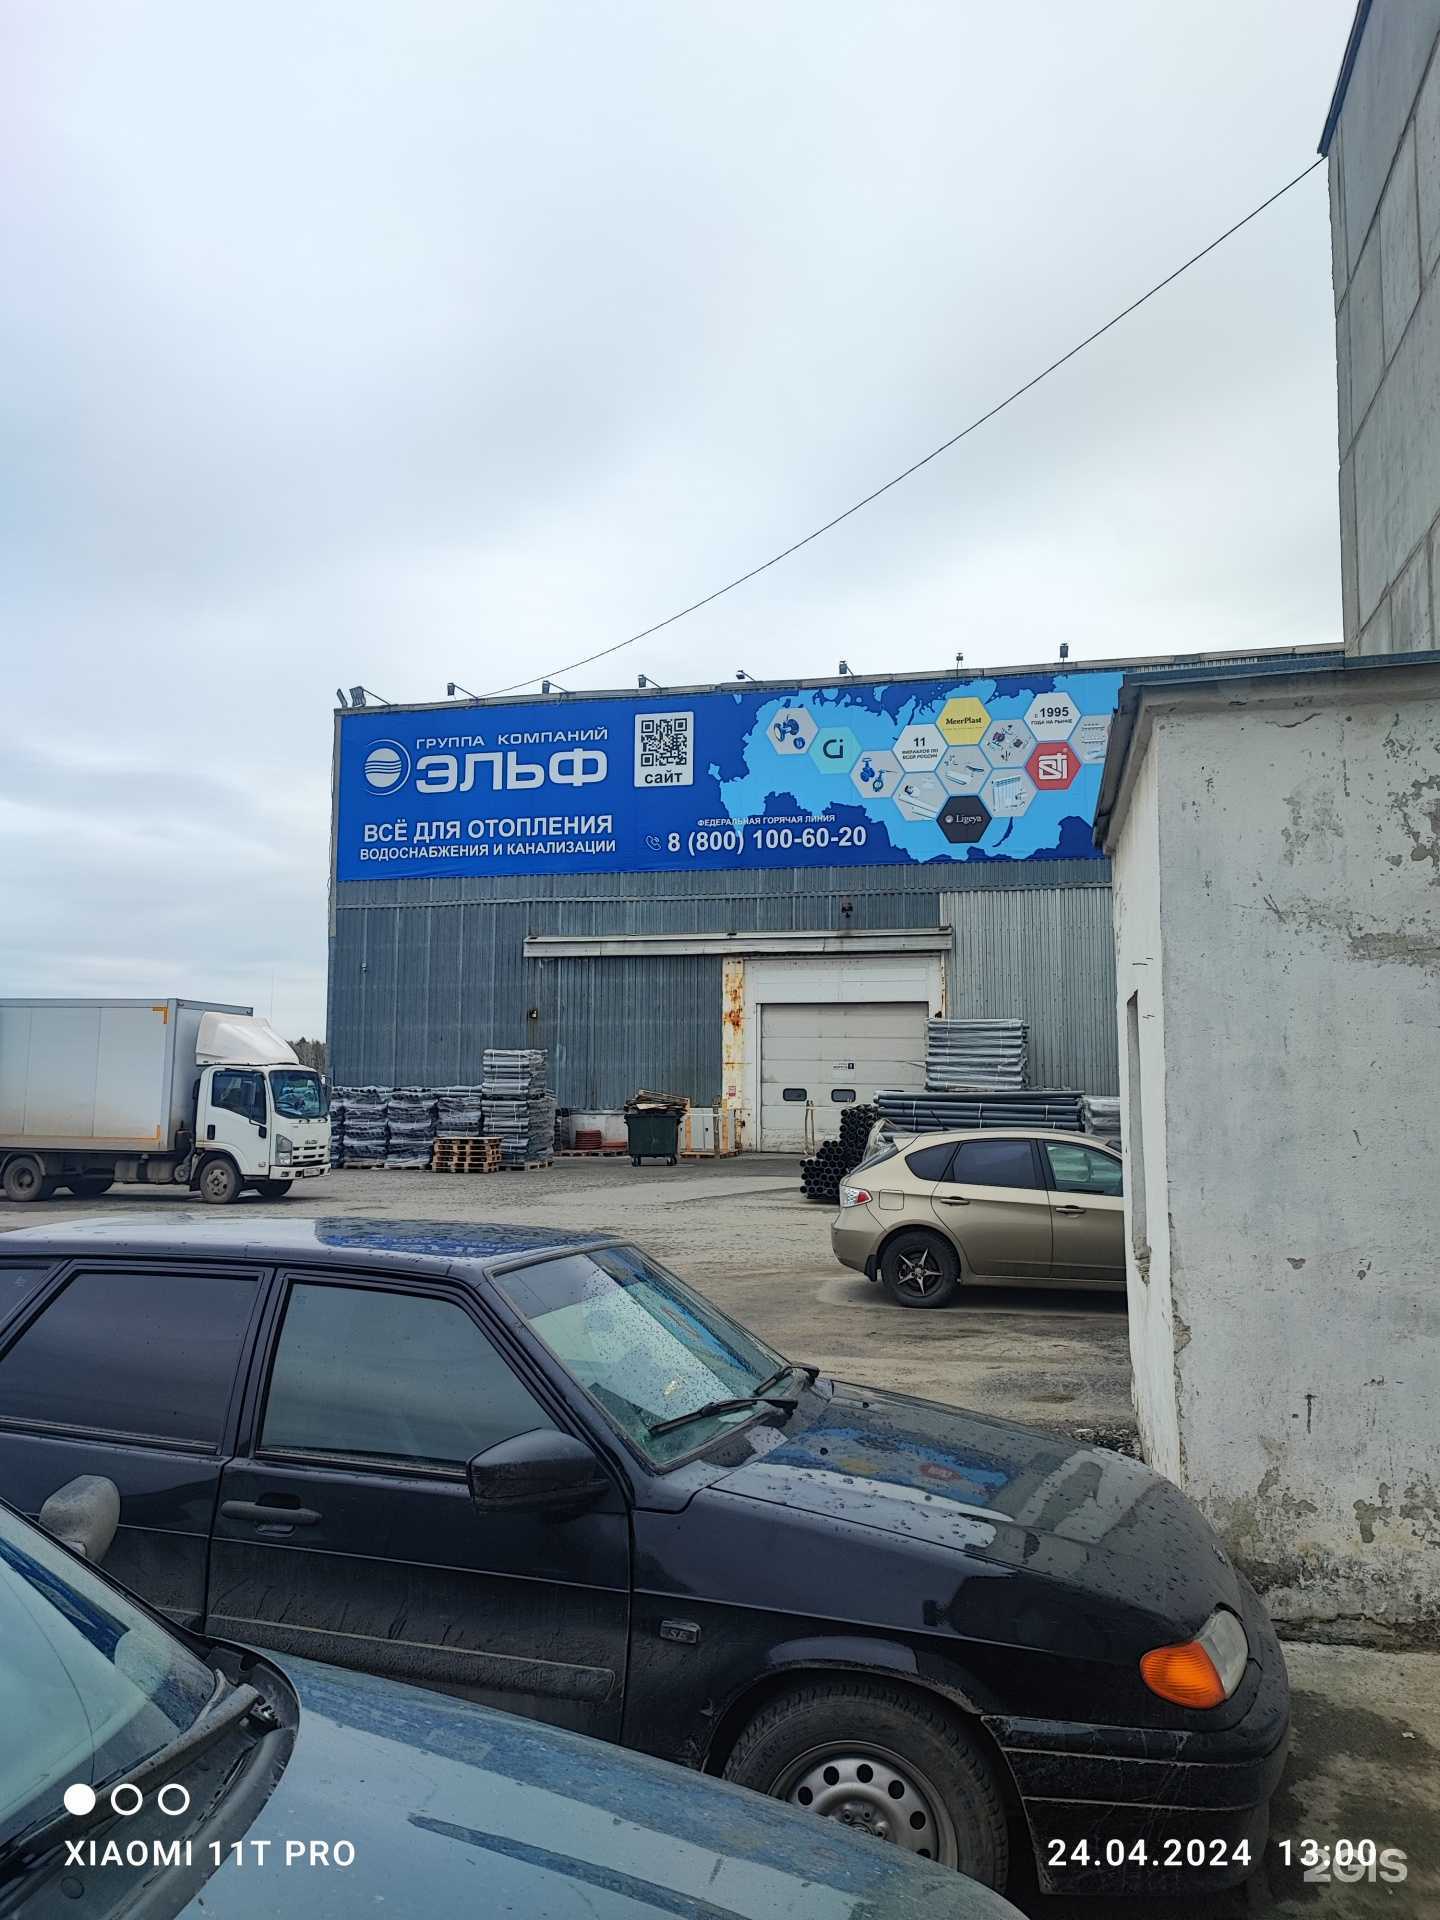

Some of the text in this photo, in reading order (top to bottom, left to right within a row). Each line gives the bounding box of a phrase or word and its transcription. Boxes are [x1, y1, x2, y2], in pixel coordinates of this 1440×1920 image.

[945, 717, 982, 725] MeerPlast
[1040, 706, 1069, 718] 1995
[416, 726, 608, 750] ГРУППА КОМПАНИЙ
[913, 736, 926, 747] 11
[416, 748, 608, 794] ЭЛЬФ
[644, 769, 683, 784] сайт
[364, 814, 613, 844] ВСЁ ДЛЯ ОТОПЛЕНИЯ
[697, 814, 836, 827] ФЕДЕРАЛЬНАЯ ГОРЯЧАЯ ЛИНИЯ
[360, 839, 616, 862] ВОДОСНАБЖЕНИЯ И КАНАЛИЗАЦИИ
[667, 826, 867, 856] 8 (800) 100-60-20
